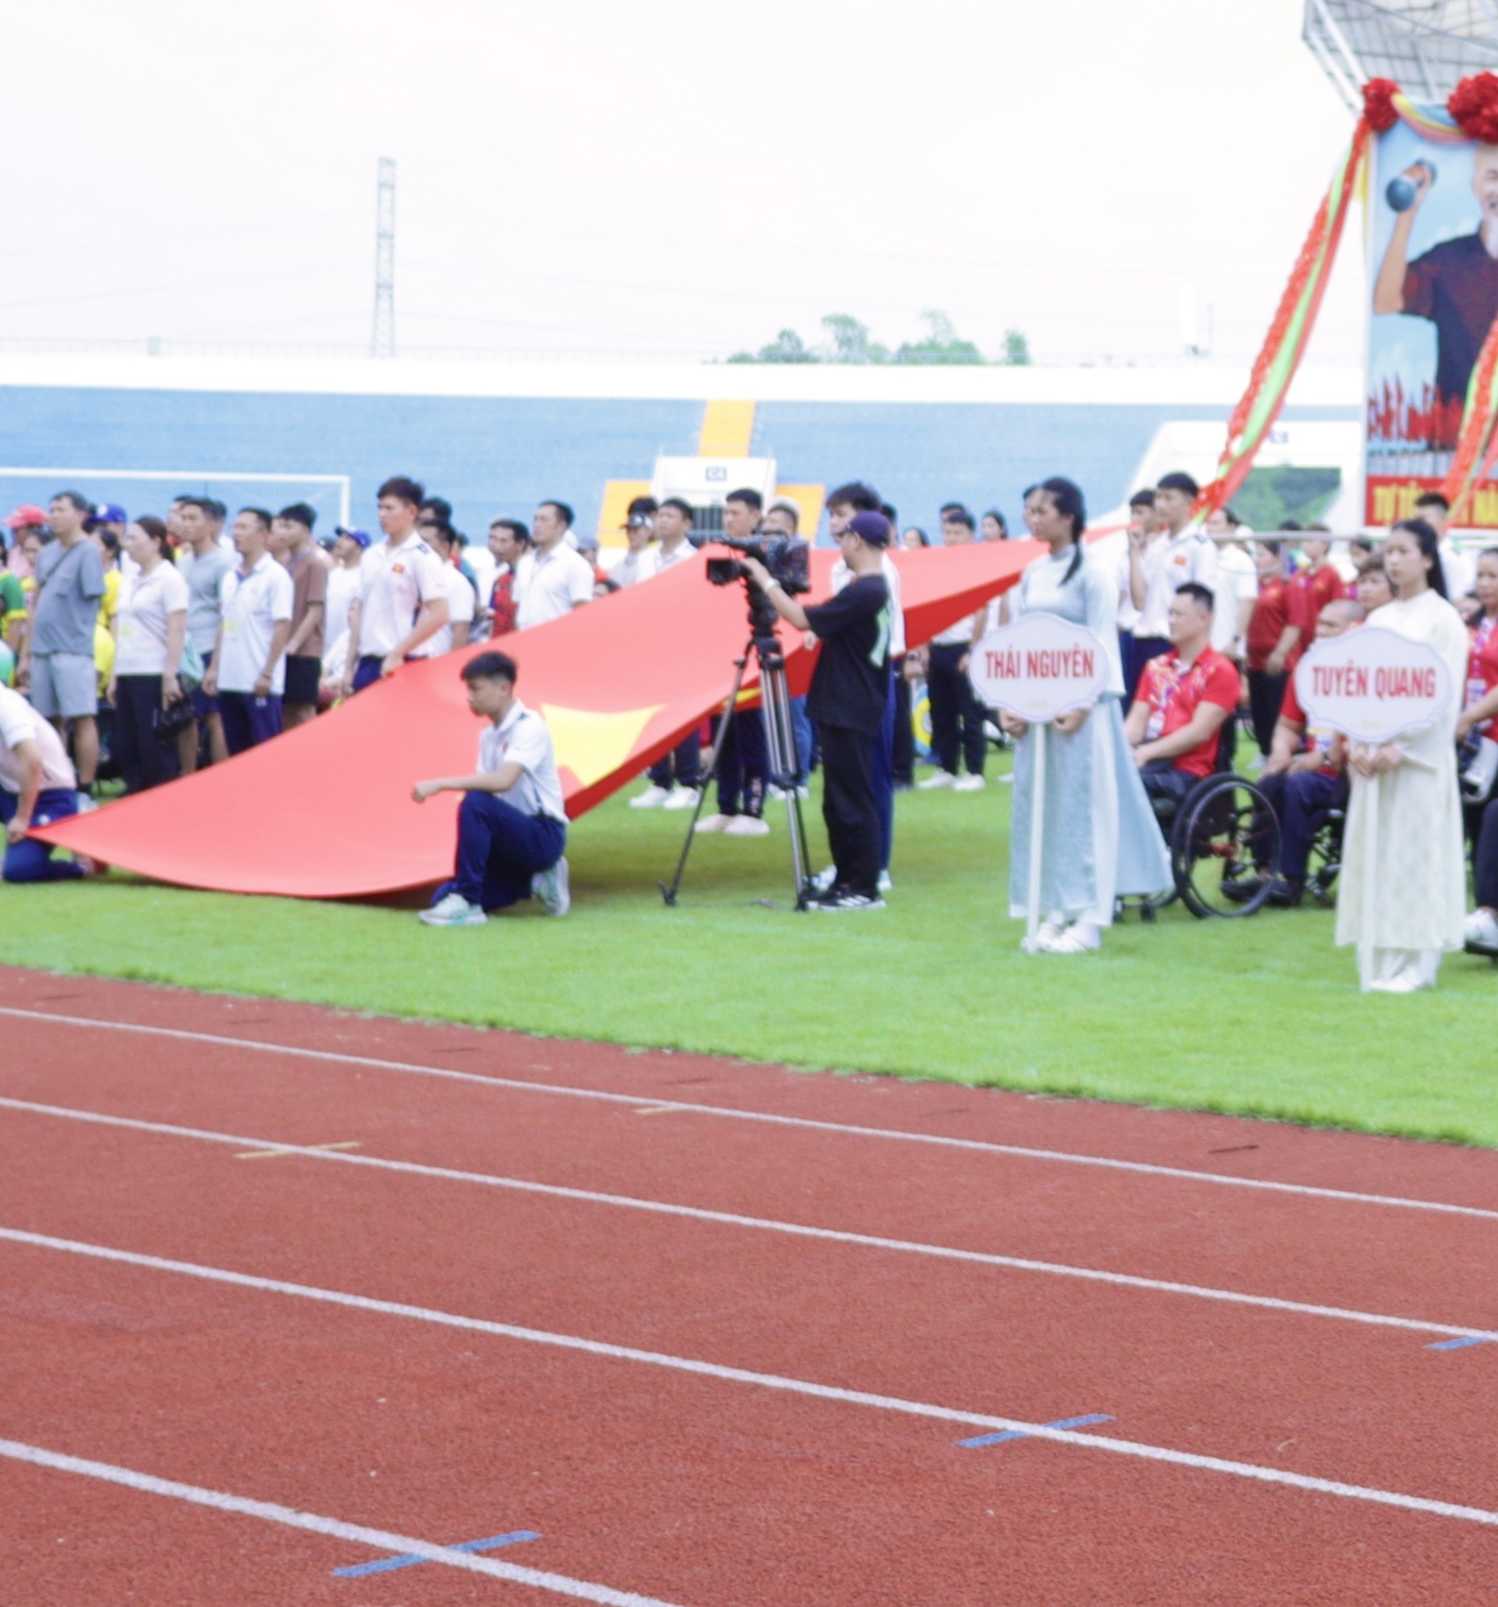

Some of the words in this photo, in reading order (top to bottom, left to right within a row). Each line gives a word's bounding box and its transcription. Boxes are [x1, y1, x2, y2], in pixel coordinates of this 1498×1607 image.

[985, 643, 1021, 680] THÁI
[1027, 642, 1094, 679] NGUYÊN
[1312, 659, 1368, 697] TUYÊN
[1375, 666, 1436, 701] QUANG
